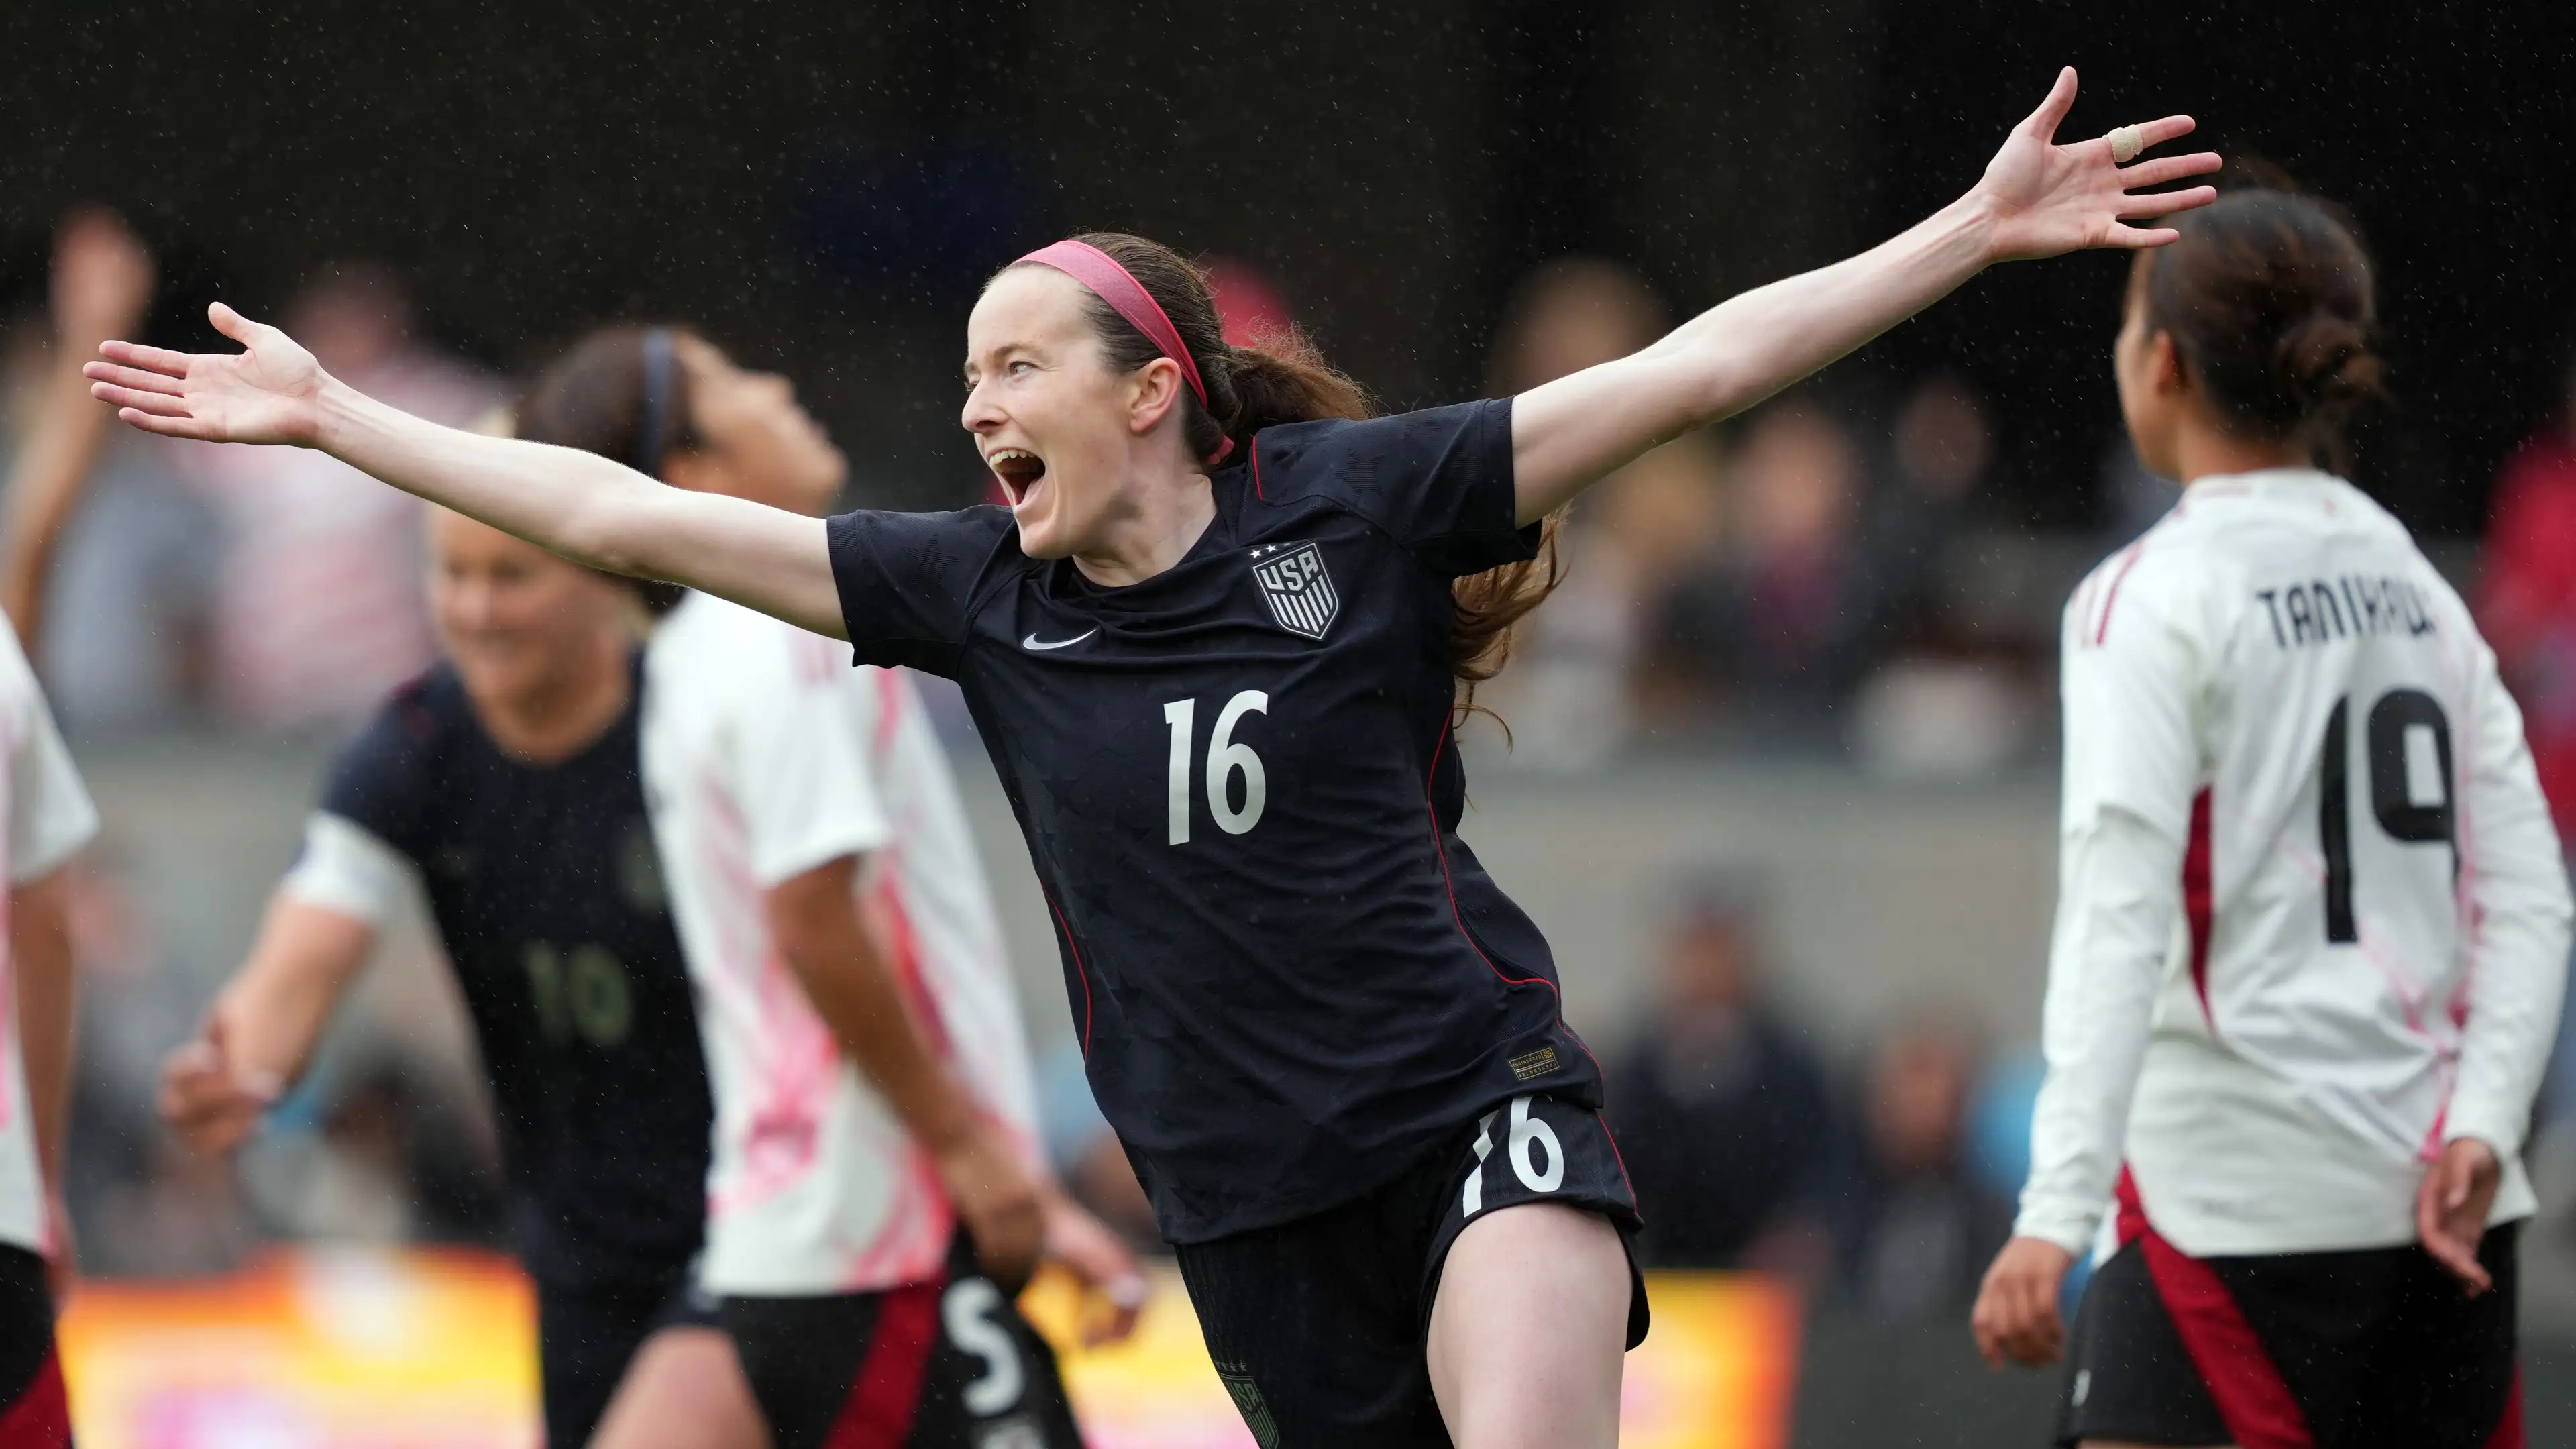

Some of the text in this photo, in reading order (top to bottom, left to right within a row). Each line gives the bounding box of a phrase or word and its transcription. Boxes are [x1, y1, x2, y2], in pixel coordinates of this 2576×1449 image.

[1260, 550, 1319, 591] USA
[1163, 690, 1269, 846] 16
[2320, 688, 2461, 945] 19
[1462, 1095, 1564, 1218] 16
